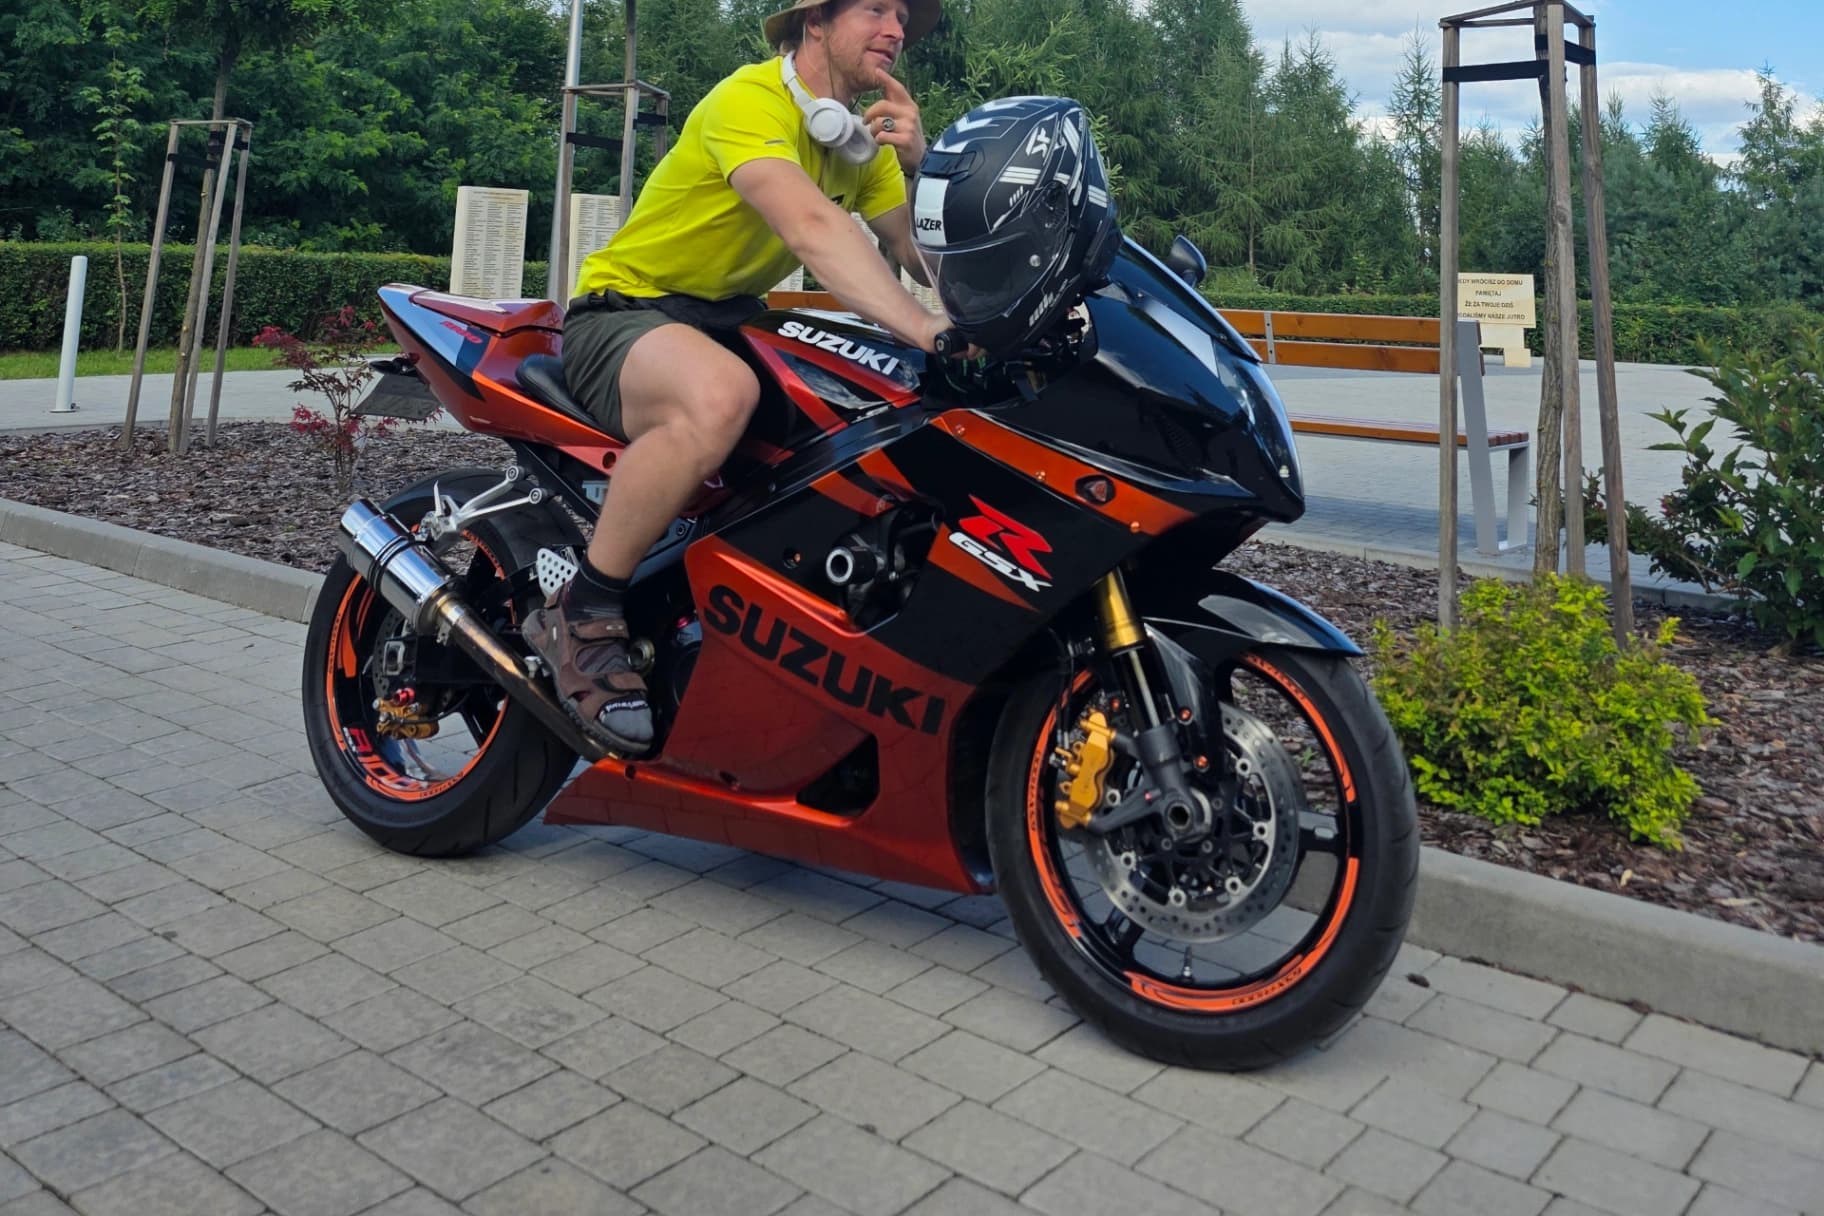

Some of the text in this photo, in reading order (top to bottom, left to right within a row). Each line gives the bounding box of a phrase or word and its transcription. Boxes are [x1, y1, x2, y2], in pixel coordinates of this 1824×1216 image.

[916, 217, 943, 231] LAZER
[777, 321, 899, 376] SUZUKI
[949, 531, 1053, 592] GSX
[959, 493, 1053, 579] R
[703, 585, 946, 736] SUZUKI
